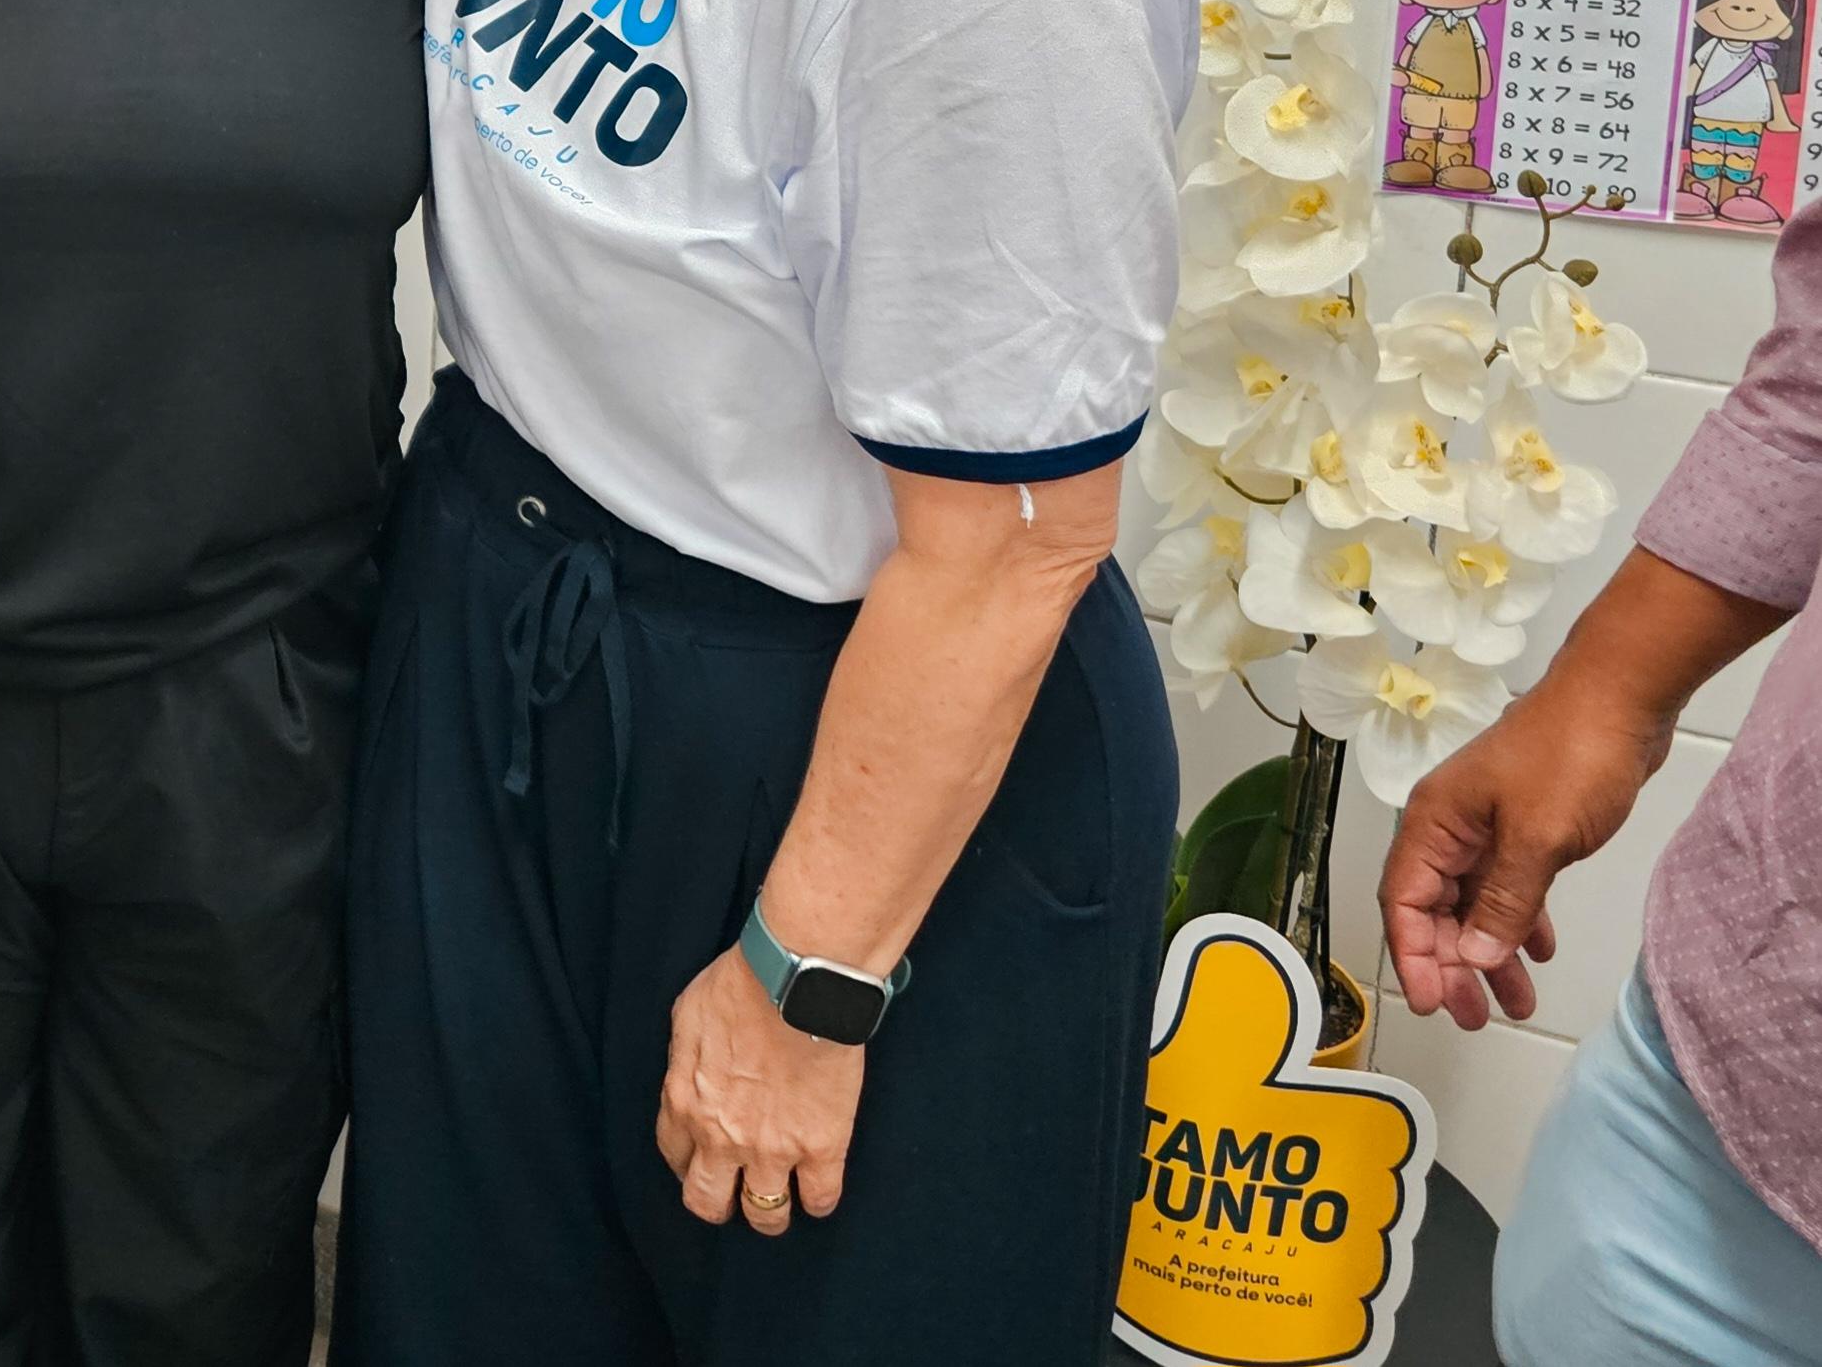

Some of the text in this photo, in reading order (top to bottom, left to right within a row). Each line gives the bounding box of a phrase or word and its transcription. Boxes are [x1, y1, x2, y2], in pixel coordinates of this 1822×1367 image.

[1510, 21, 1524, 38] 8
[1560, 24, 1575, 43] 5
[1609, 28, 1641, 49] 40
[1151, 1221, 1298, 1258] ARACAJU
[1133, 1256, 1314, 1309] mais perto de você!
[1168, 1253, 1280, 1287] A prefeitura
